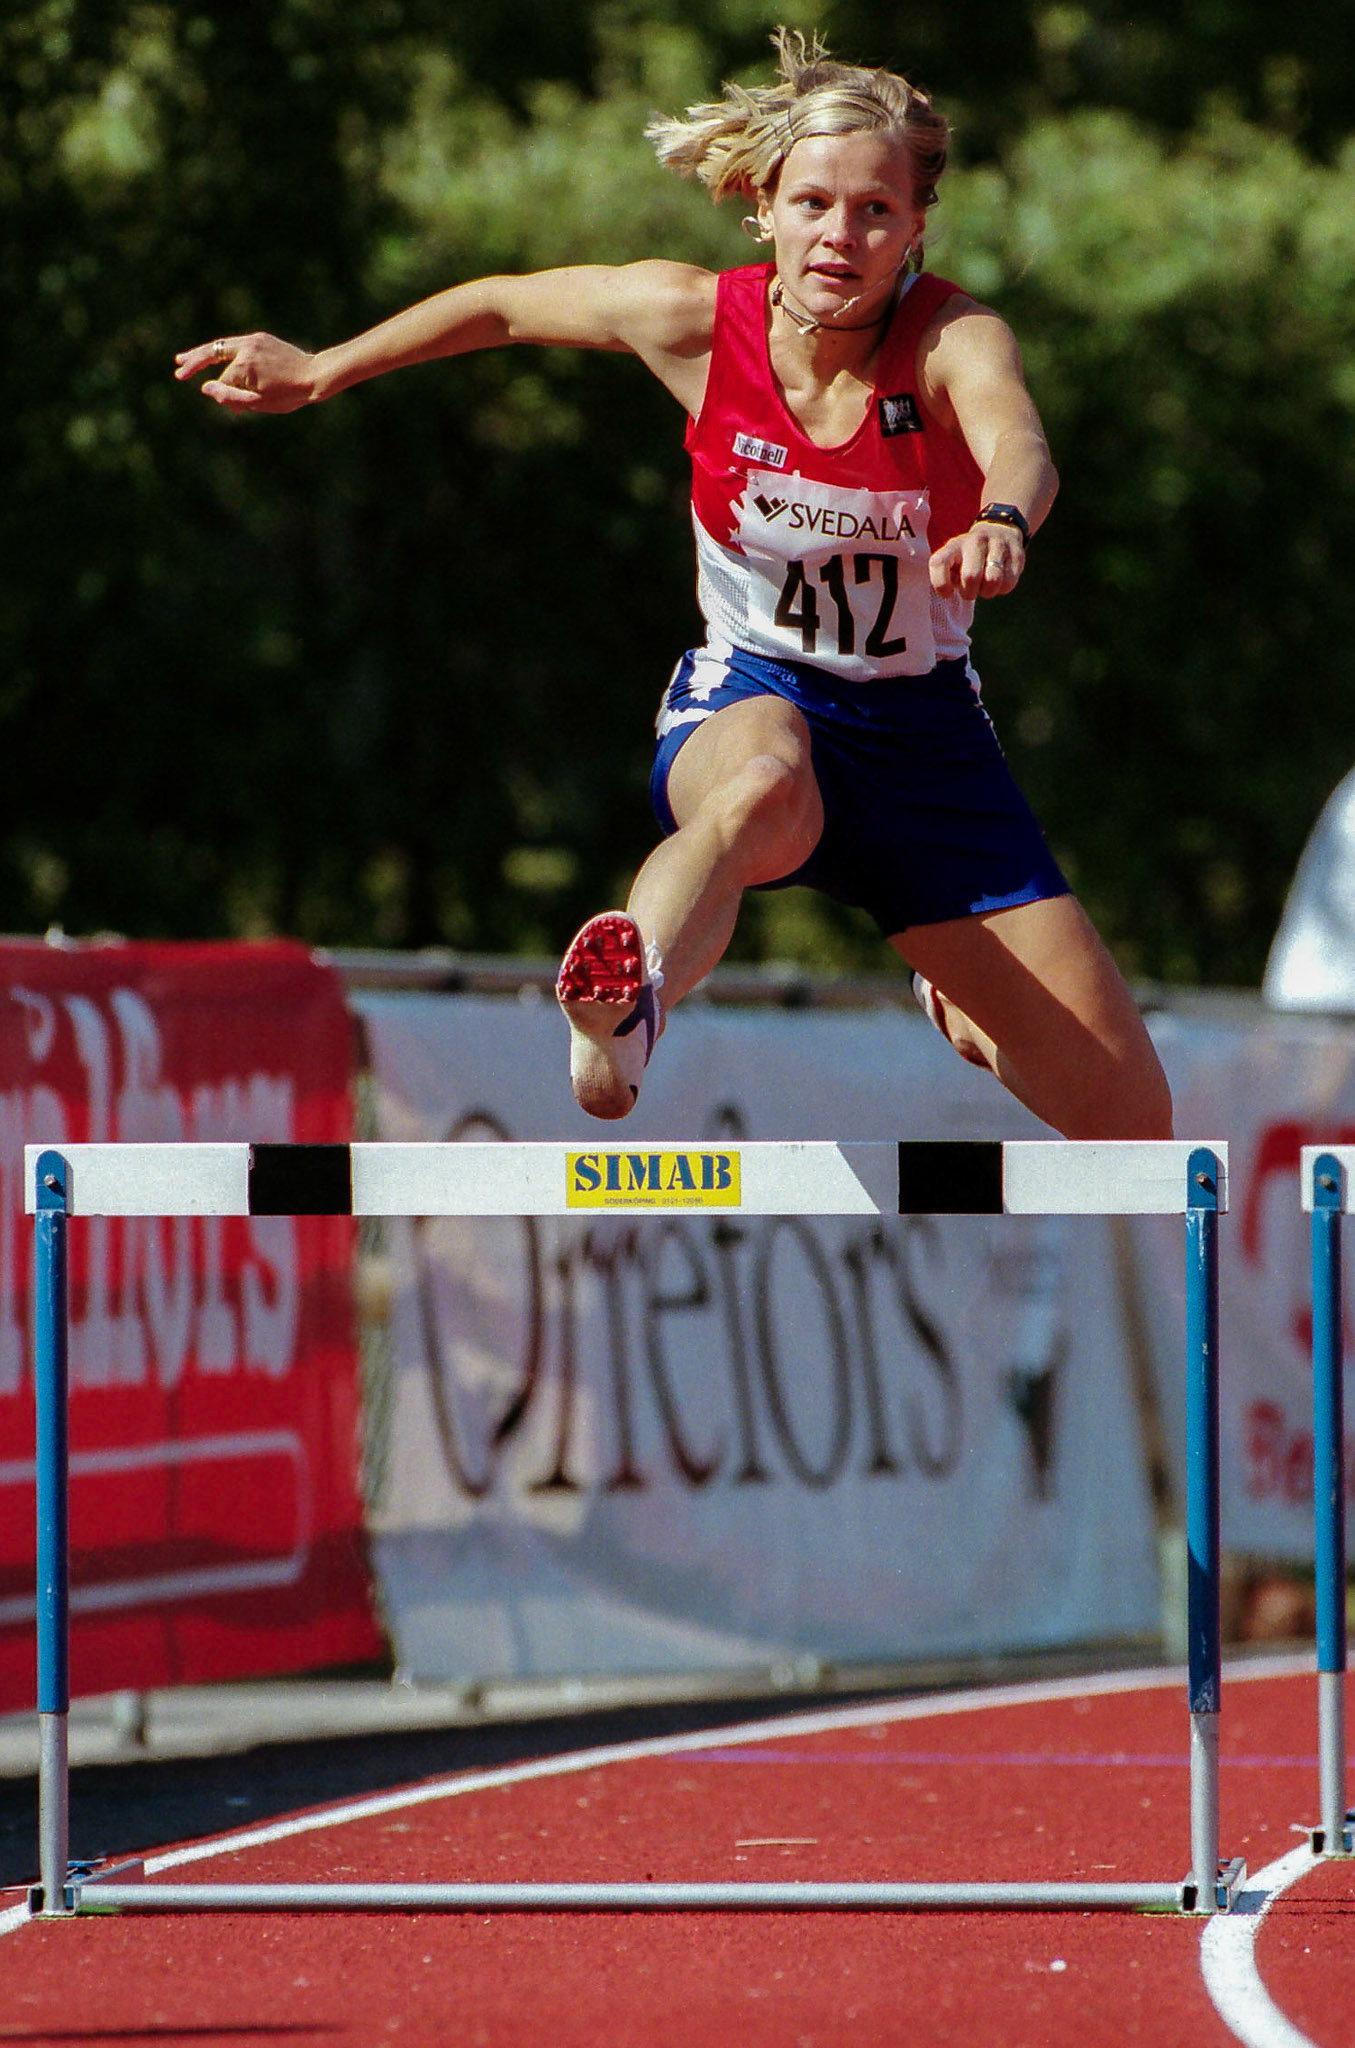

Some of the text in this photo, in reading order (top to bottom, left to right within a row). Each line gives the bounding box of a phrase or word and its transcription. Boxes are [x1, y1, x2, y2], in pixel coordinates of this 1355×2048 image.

[788, 502, 916, 541] SVEDALA
[774, 553, 907, 658] 412
[574, 1154, 732, 1192] SIMAB
